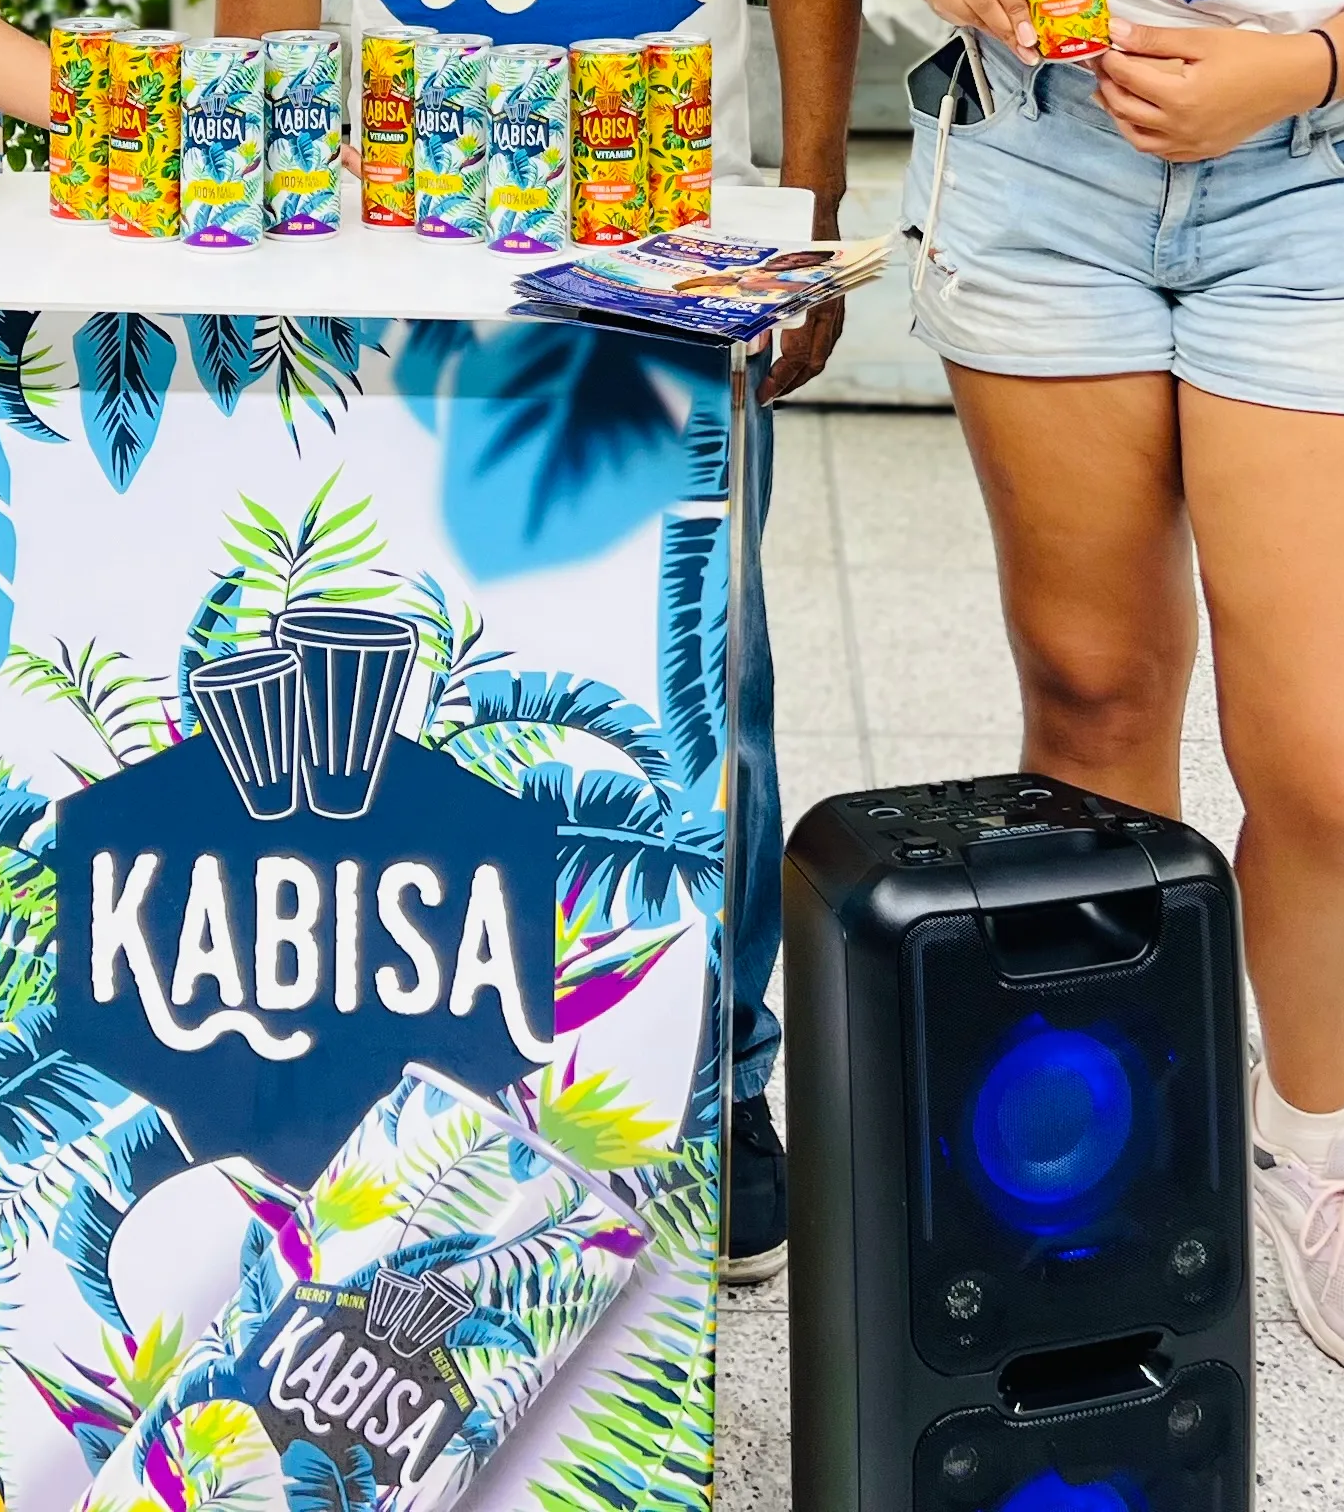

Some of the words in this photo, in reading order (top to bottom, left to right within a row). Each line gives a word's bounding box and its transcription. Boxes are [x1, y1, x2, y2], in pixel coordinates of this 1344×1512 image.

[274, 108, 330, 135] KABISA
[363, 95, 408, 127] KABISA
[188, 117, 245, 144] KABISA
[370, 132, 405, 142] VITAMIN
[493, 122, 550, 152] KABISA
[582, 116, 636, 145] KABISA
[595, 149, 633, 160] VITAMIN
[280, 176, 304, 188] 100%
[595, 232, 611, 241] 250
[613, 232, 623, 240] ml
[90, 851, 555, 1064] KABISA
[294, 1286, 332, 1304] ENERGY
[336, 1292, 367, 1311] DRINK
[429, 1346, 456, 1383] ENERGY
[258, 1306, 446, 1490] KABISA
